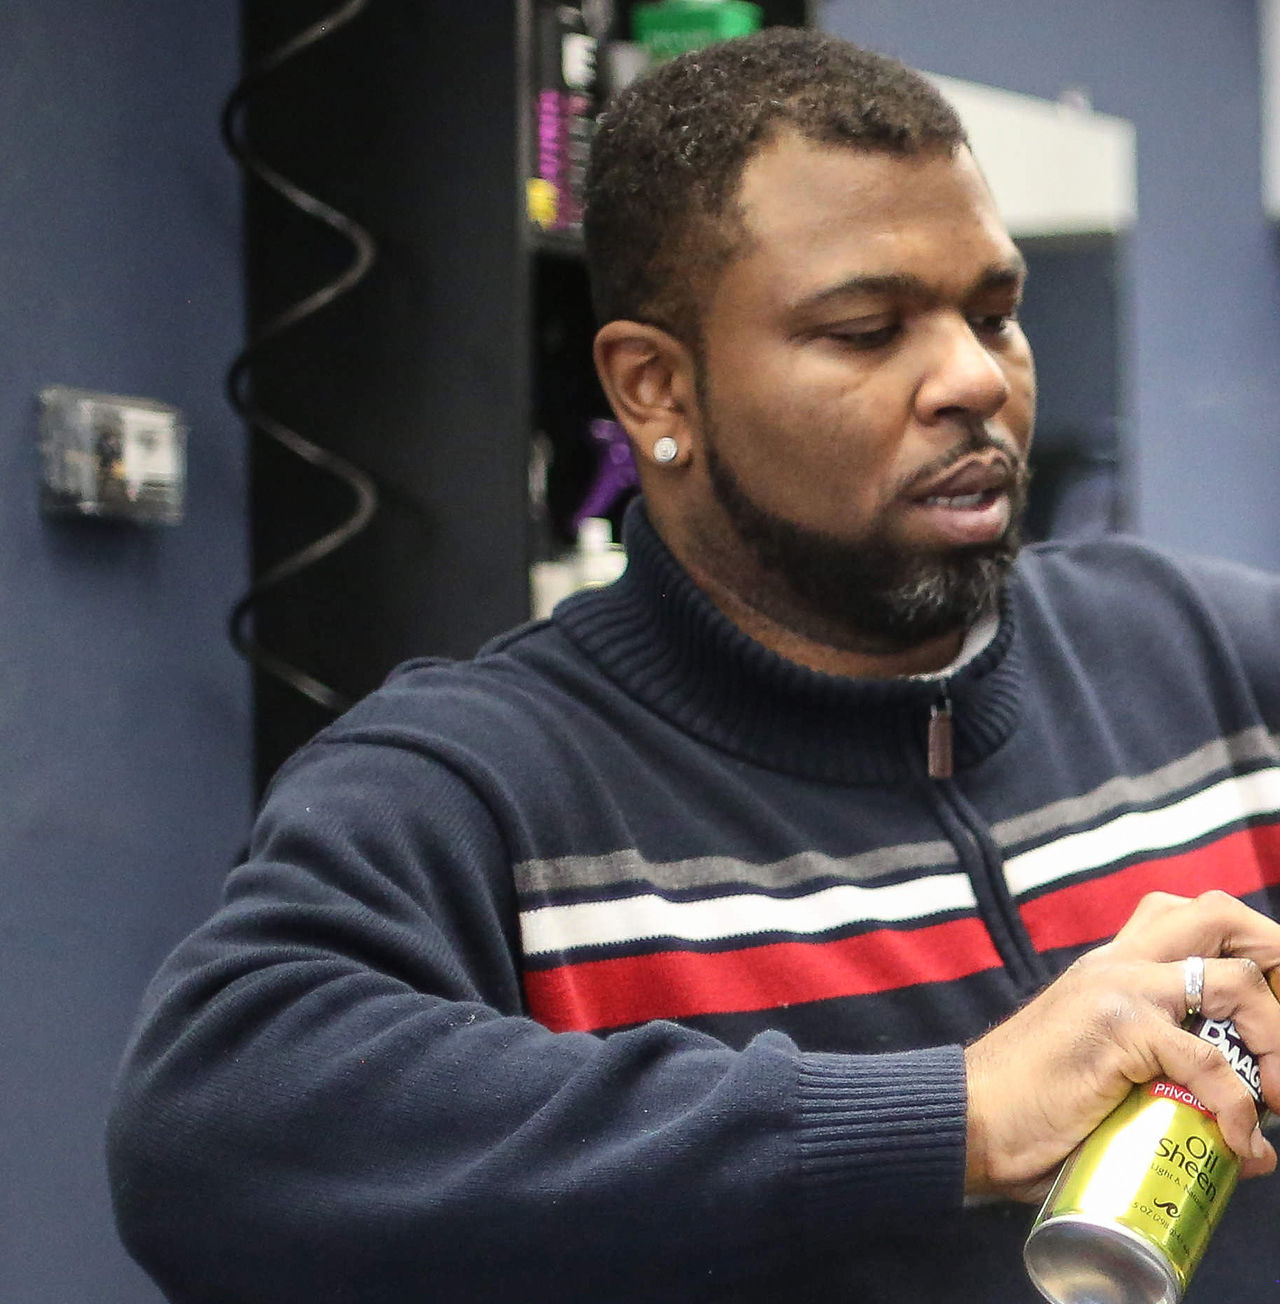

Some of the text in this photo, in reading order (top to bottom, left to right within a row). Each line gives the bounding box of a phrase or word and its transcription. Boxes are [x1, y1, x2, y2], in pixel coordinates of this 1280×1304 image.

[1150, 1162, 1173, 1180] Light
[1154, 1137, 1217, 1203] Sheen
[1186, 1136, 1219, 1173] Oil
